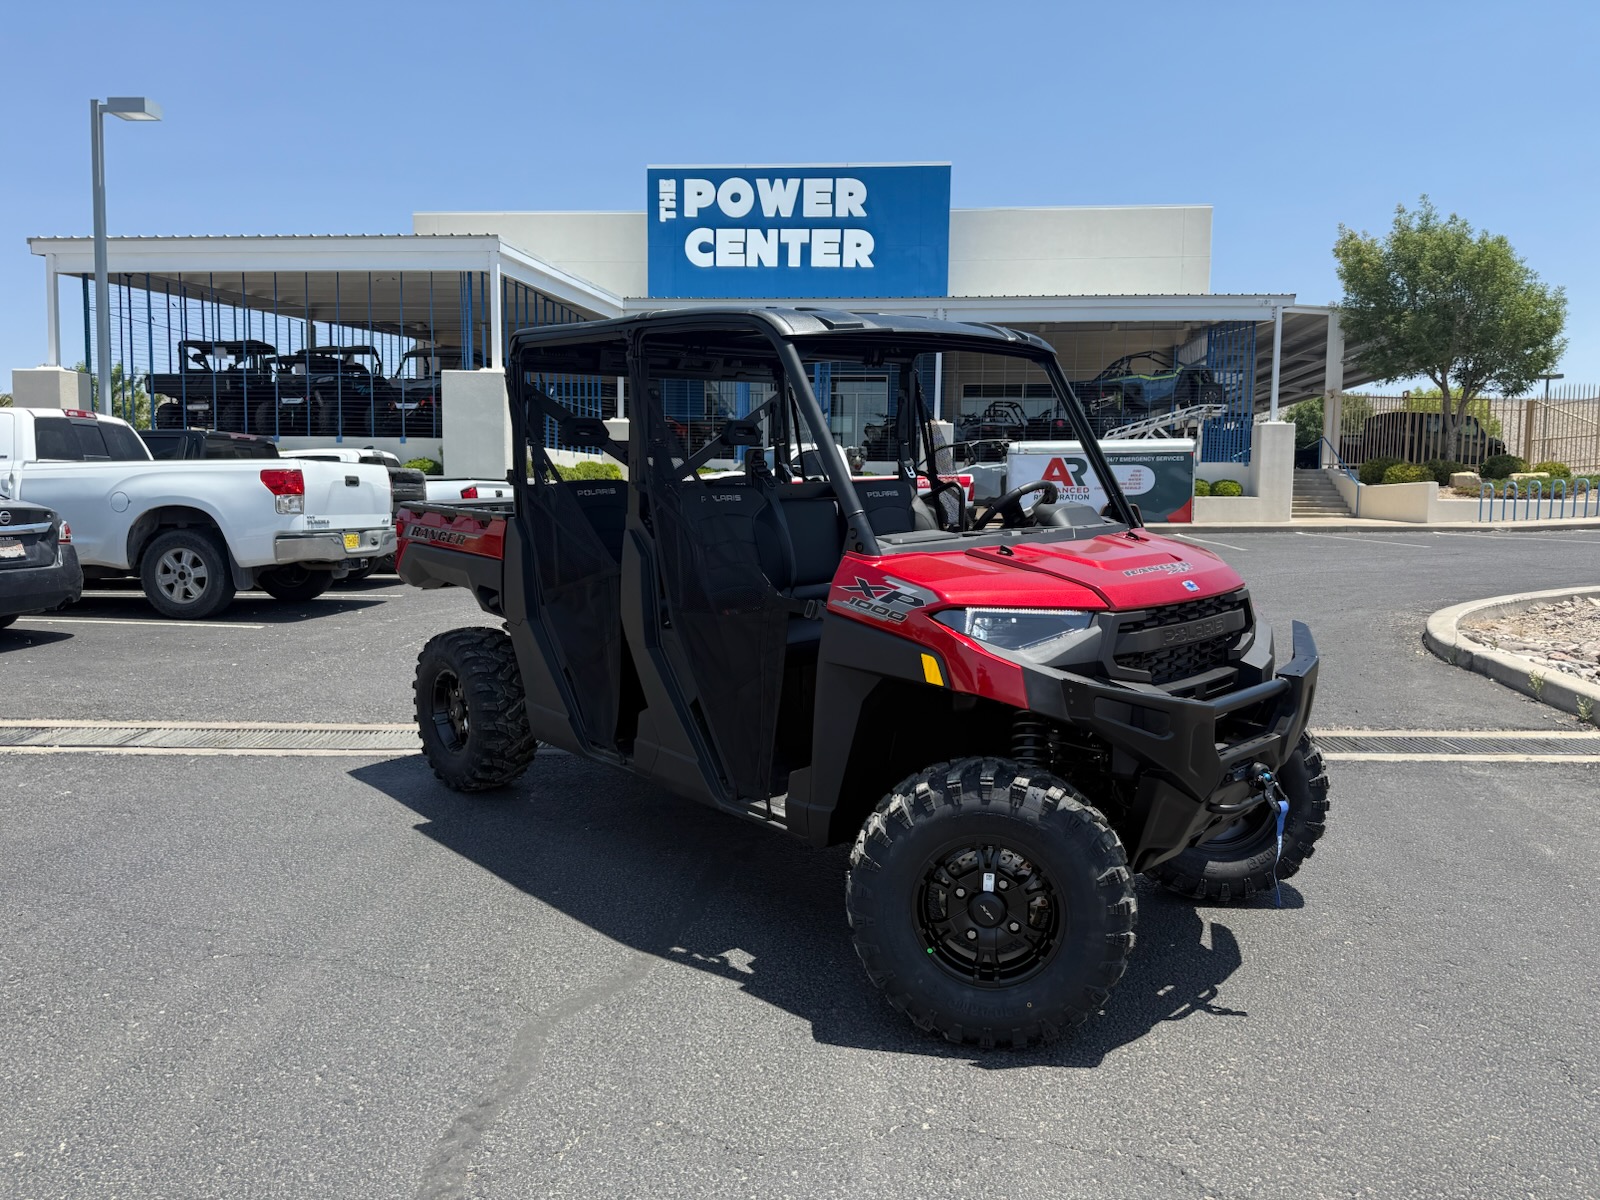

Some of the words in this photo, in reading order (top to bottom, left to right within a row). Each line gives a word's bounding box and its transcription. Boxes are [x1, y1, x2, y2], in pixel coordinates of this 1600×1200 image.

[659, 179, 676, 222] THE
[684, 177, 867, 218] POWER
[684, 227, 875, 267] CENTER
[1041, 457, 1088, 486] AR
[577, 487, 616, 496] POLARIS
[700, 494, 741, 502] PLARIS
[866, 490, 899, 498] POLARIS
[410, 525, 467, 546] RANGER
[1122, 562, 1192, 577] RANGER
[836, 576, 927, 608] XP
[849, 596, 908, 622] 1000
[1163, 618, 1225, 645] POLARIS
